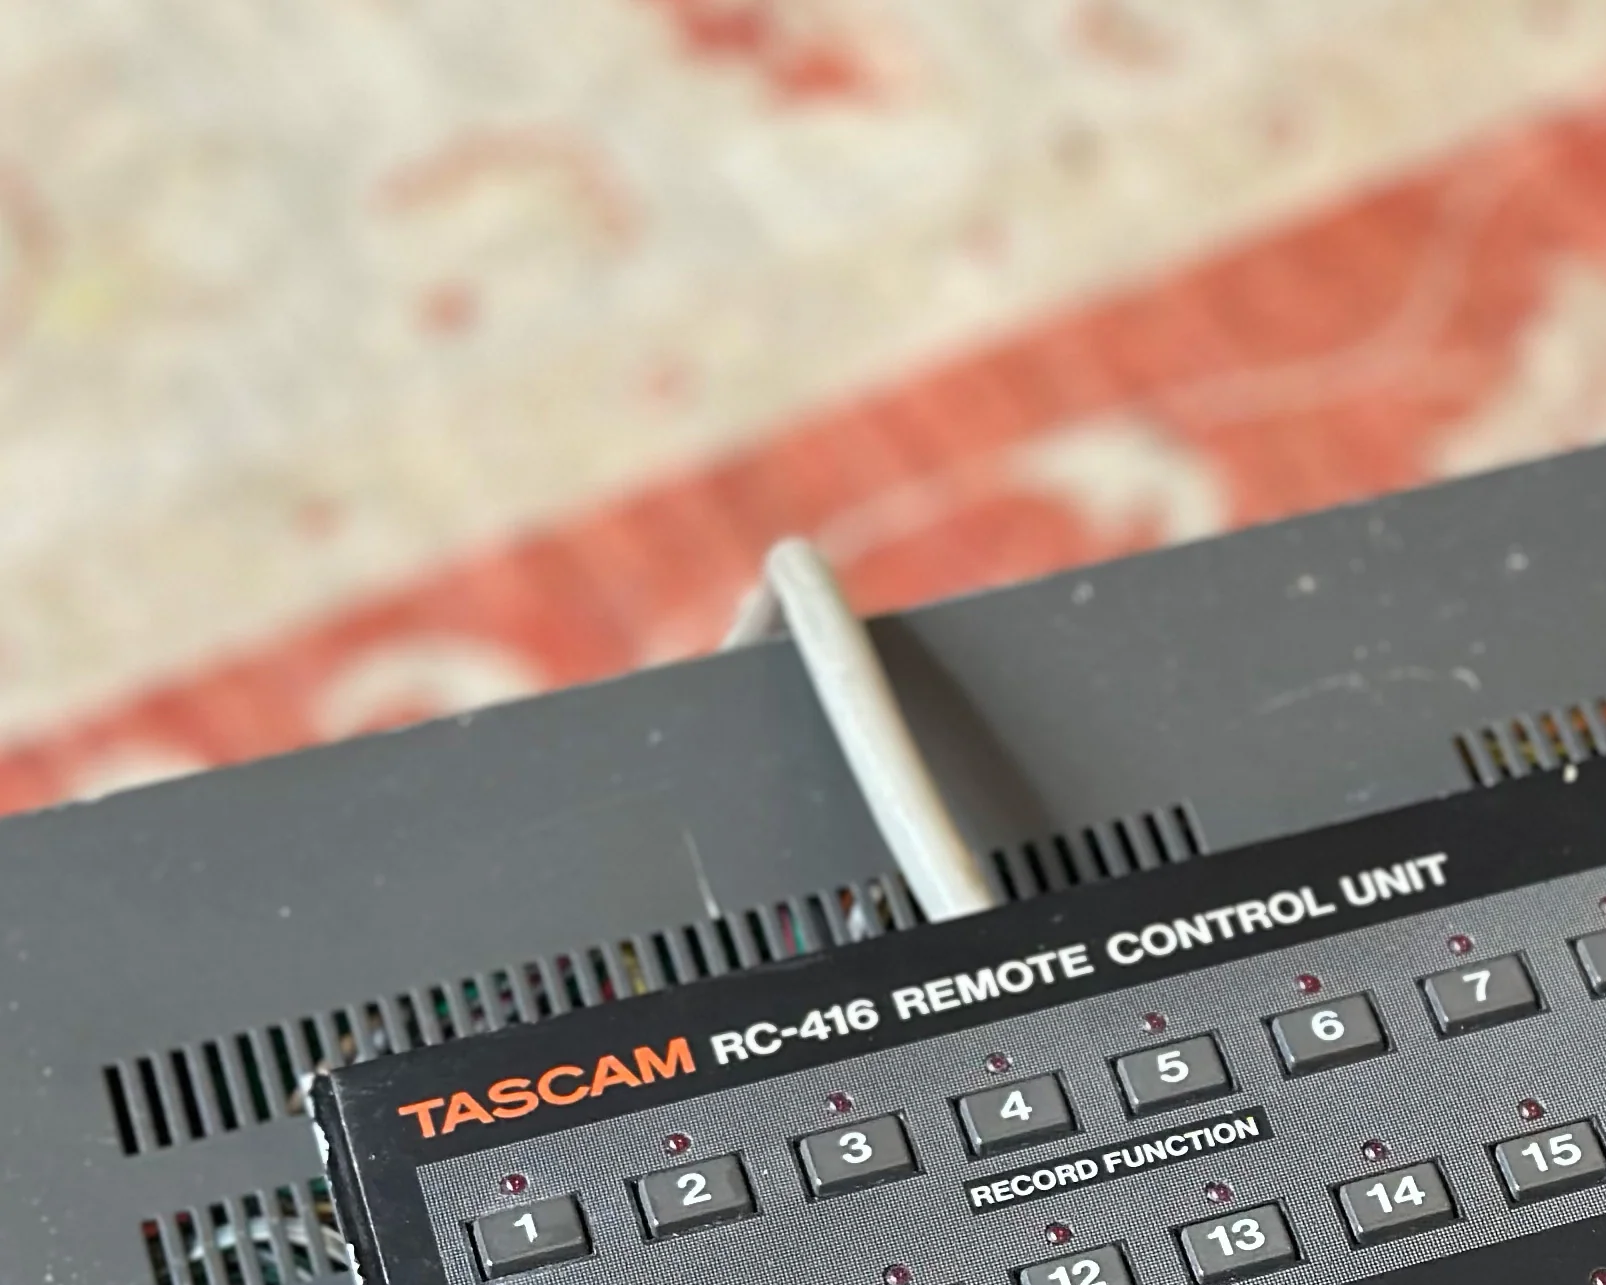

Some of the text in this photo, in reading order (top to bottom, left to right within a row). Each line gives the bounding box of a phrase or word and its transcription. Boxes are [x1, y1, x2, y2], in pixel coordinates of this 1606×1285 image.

[711, 854, 1446, 1064] RC-416 REMOTE CONTROL UNIT
[1463, 971, 1490, 1001] 7
[1312, 1011, 1344, 1040] 6
[1158, 1051, 1188, 1082] 5
[398, 1037, 696, 1139] TASCAM
[1001, 1091, 1032, 1120] 4
[840, 1132, 872, 1163] 3
[971, 1116, 1260, 1208] RECORD FUNCTION
[1522, 1134, 1581, 1171] 15
[677, 1173, 711, 1205] 2
[1367, 1176, 1425, 1212] 14
[514, 1214, 537, 1242] 1
[1208, 1219, 1265, 1255] 13
